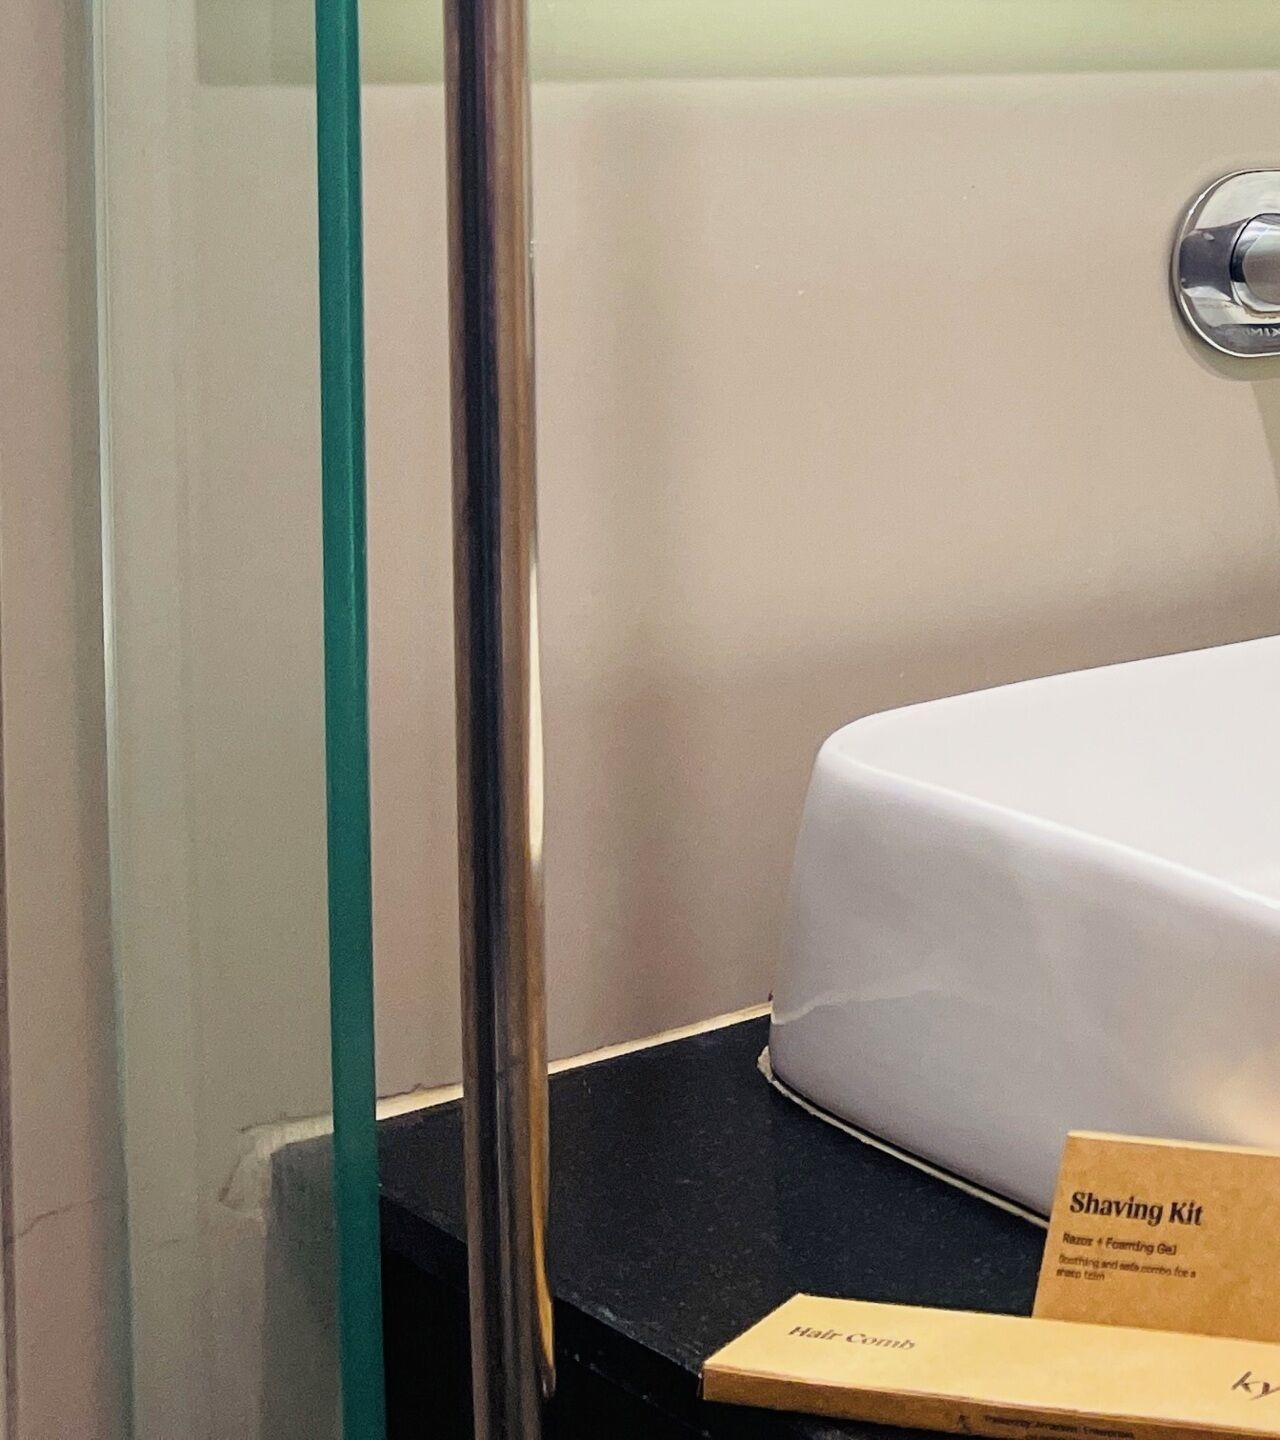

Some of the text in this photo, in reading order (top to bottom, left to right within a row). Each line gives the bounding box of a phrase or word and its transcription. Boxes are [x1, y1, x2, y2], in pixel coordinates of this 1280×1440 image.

[1069, 1191, 1204, 1227] Shaving Kit
[1105, 1237, 1155, 1255] Foaming
[1156, 1243, 1178, 1256] Gel
[788, 1326, 916, 1350] Hair Comb
